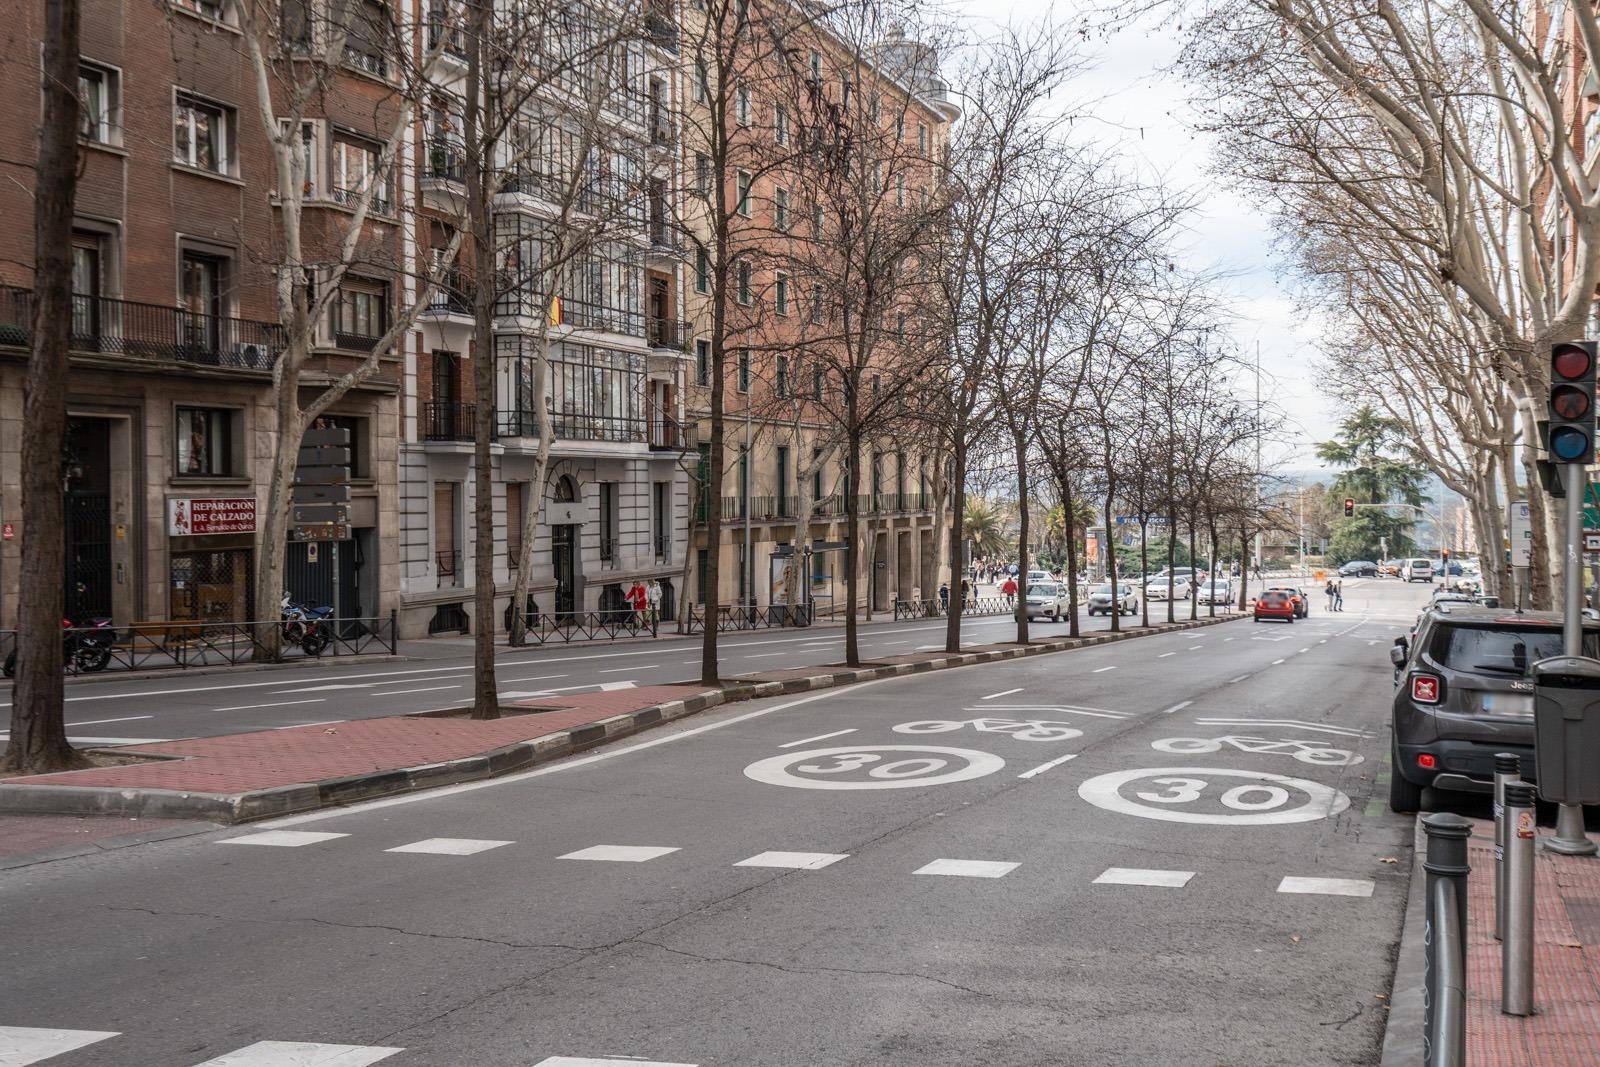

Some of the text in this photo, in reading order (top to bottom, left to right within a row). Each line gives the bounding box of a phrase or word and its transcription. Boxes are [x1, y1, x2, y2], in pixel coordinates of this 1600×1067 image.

[209, 513, 254, 521] CALZADO
[1511, 681, 1534, 690] Jeep
[797, 753, 948, 779] 30
[1136, 777, 1289, 811] 30
